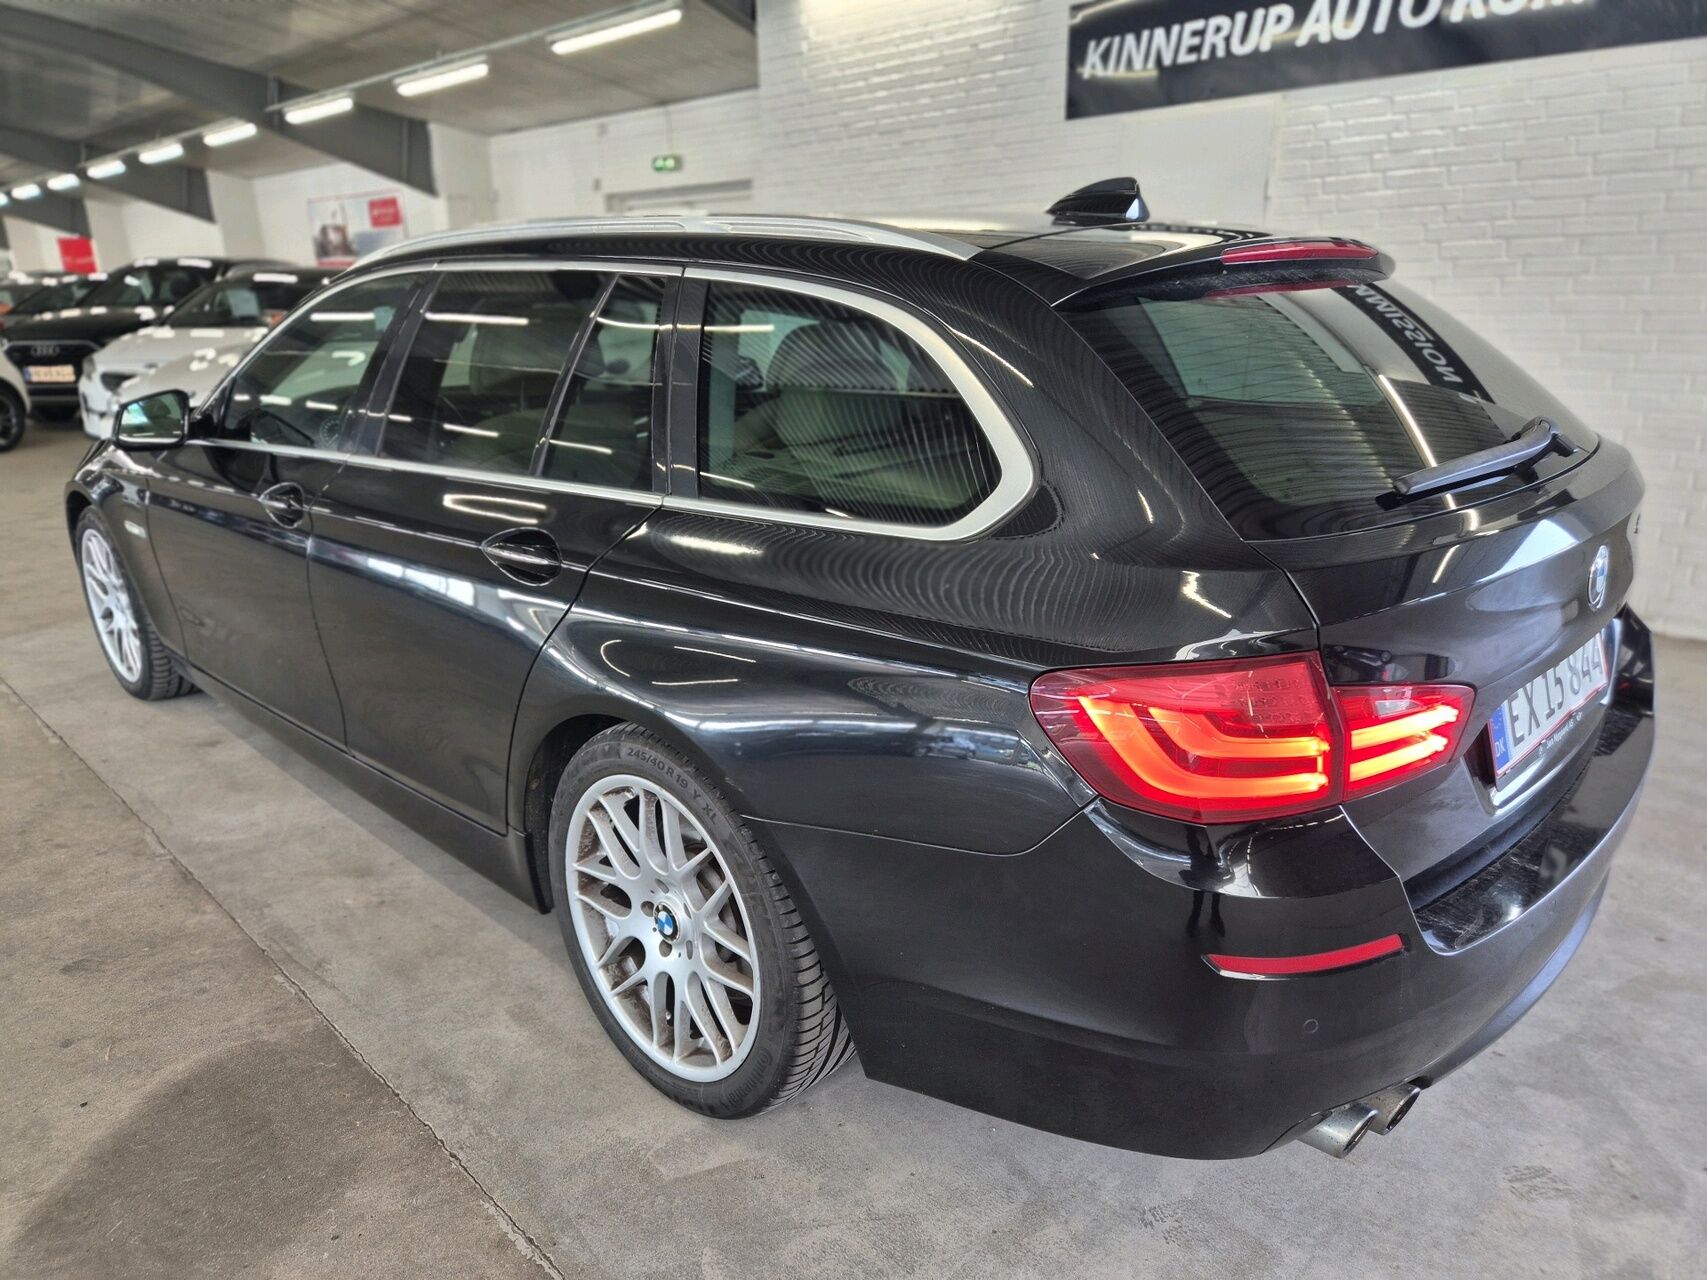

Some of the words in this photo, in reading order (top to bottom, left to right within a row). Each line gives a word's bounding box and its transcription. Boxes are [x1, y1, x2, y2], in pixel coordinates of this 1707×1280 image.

[1082, 3, 1295, 80] KINNERUP
[1295, 0, 1443, 47] AUTO
[1507, 681, 1540, 747] EX
[1542, 666, 1564, 720] 15
[627, 748, 665, 771] 245/40
[665, 766, 675, 778] R
[676, 774, 688, 788] 19
[1495, 739, 1506, 757] DK
